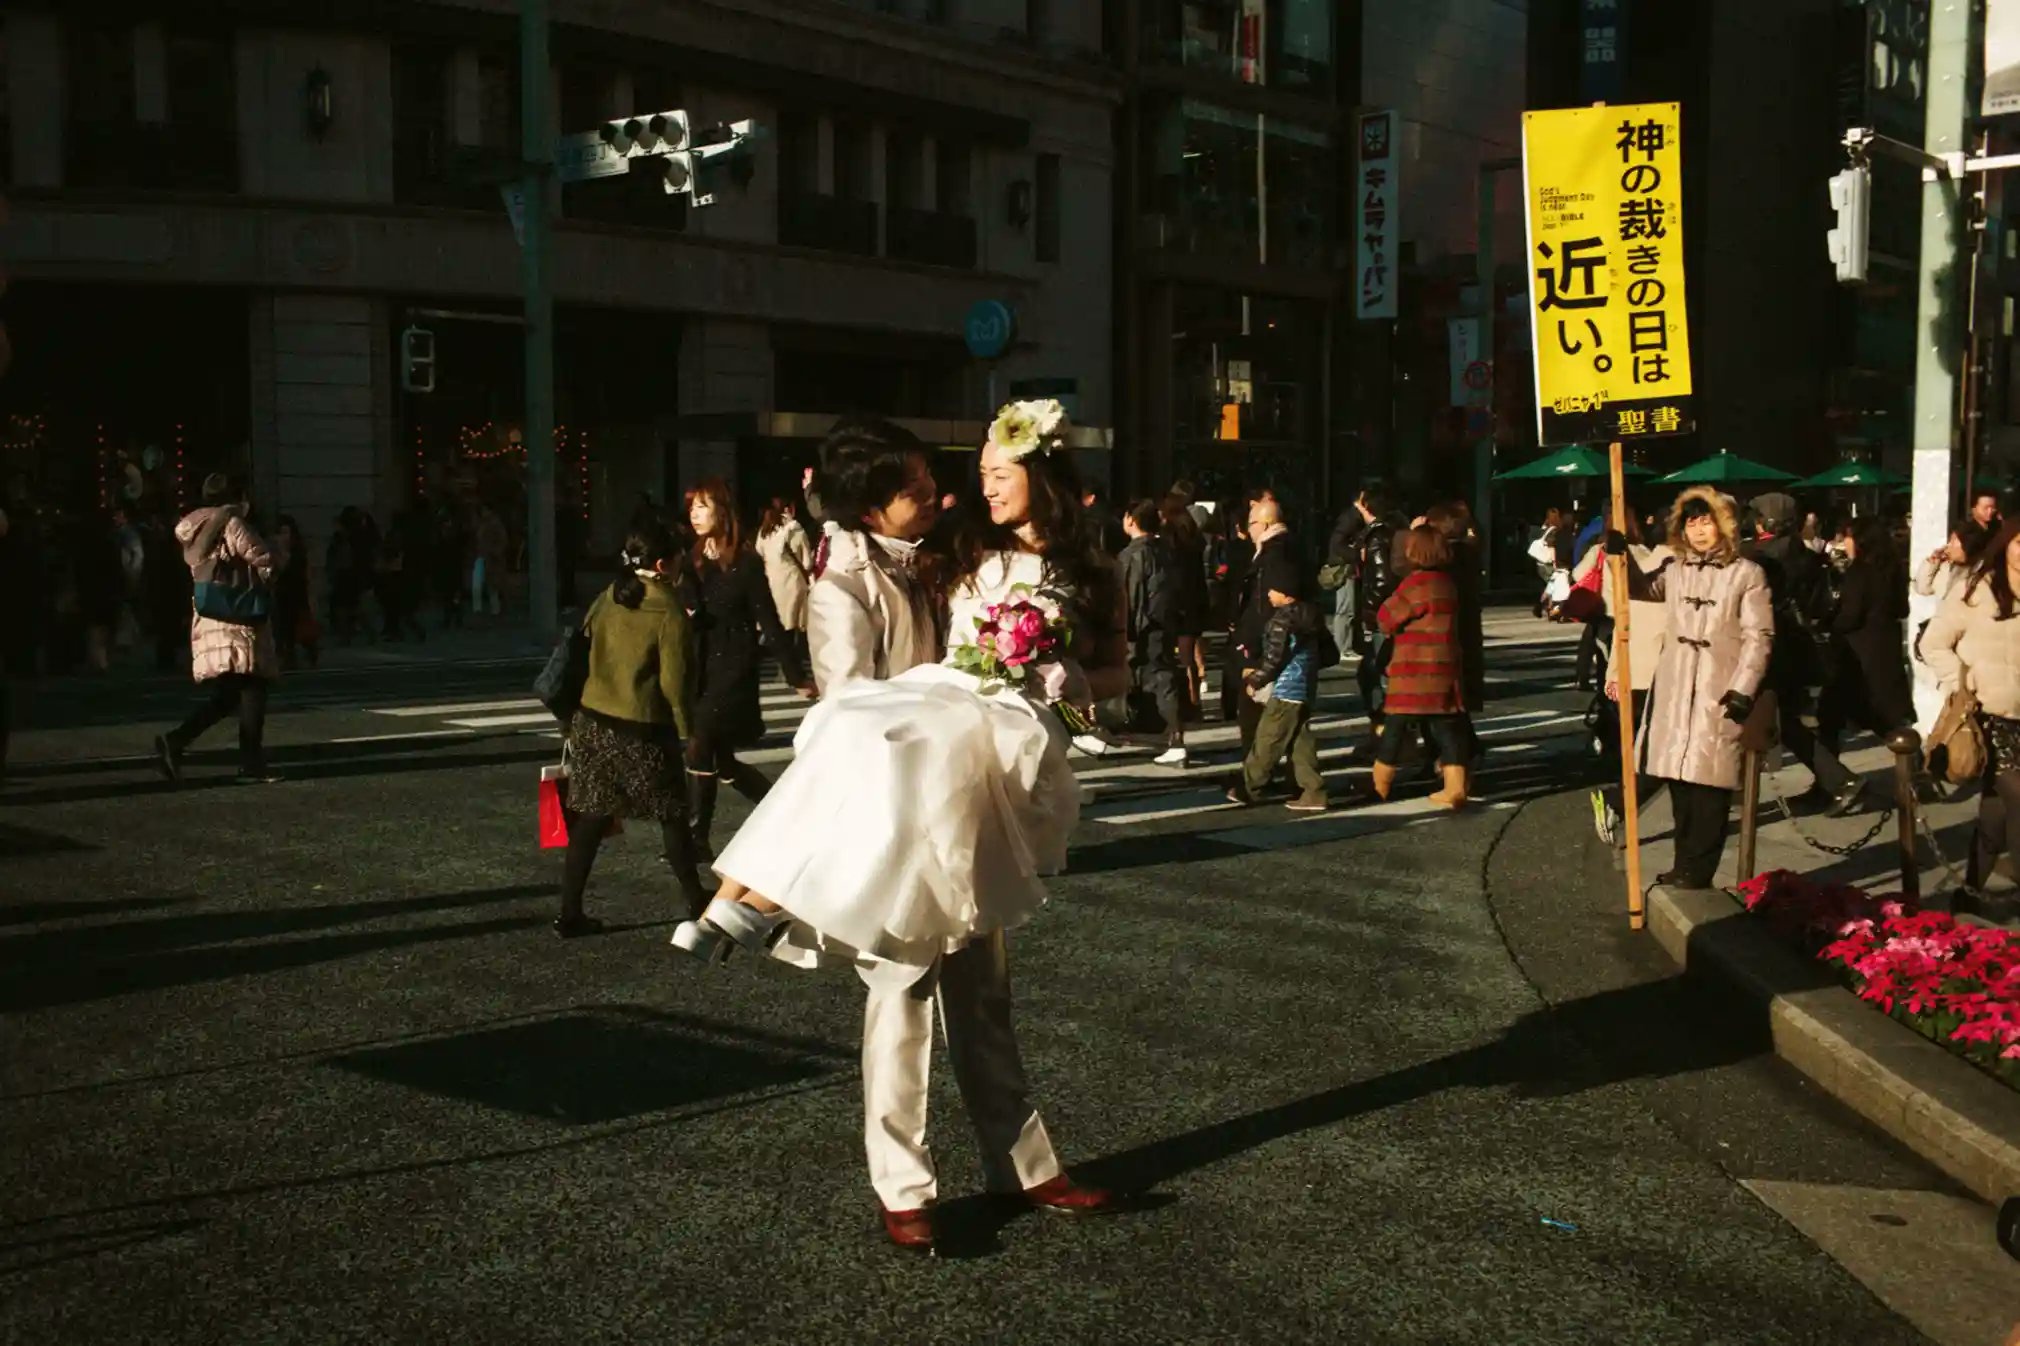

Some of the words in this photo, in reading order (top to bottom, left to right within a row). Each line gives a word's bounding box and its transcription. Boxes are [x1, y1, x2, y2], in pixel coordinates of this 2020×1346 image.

[1537, 236, 1613, 373] 近い。
[1616, 118, 1671, 384] 神の裁きの日は
[1617, 406, 1682, 435] 聖書
